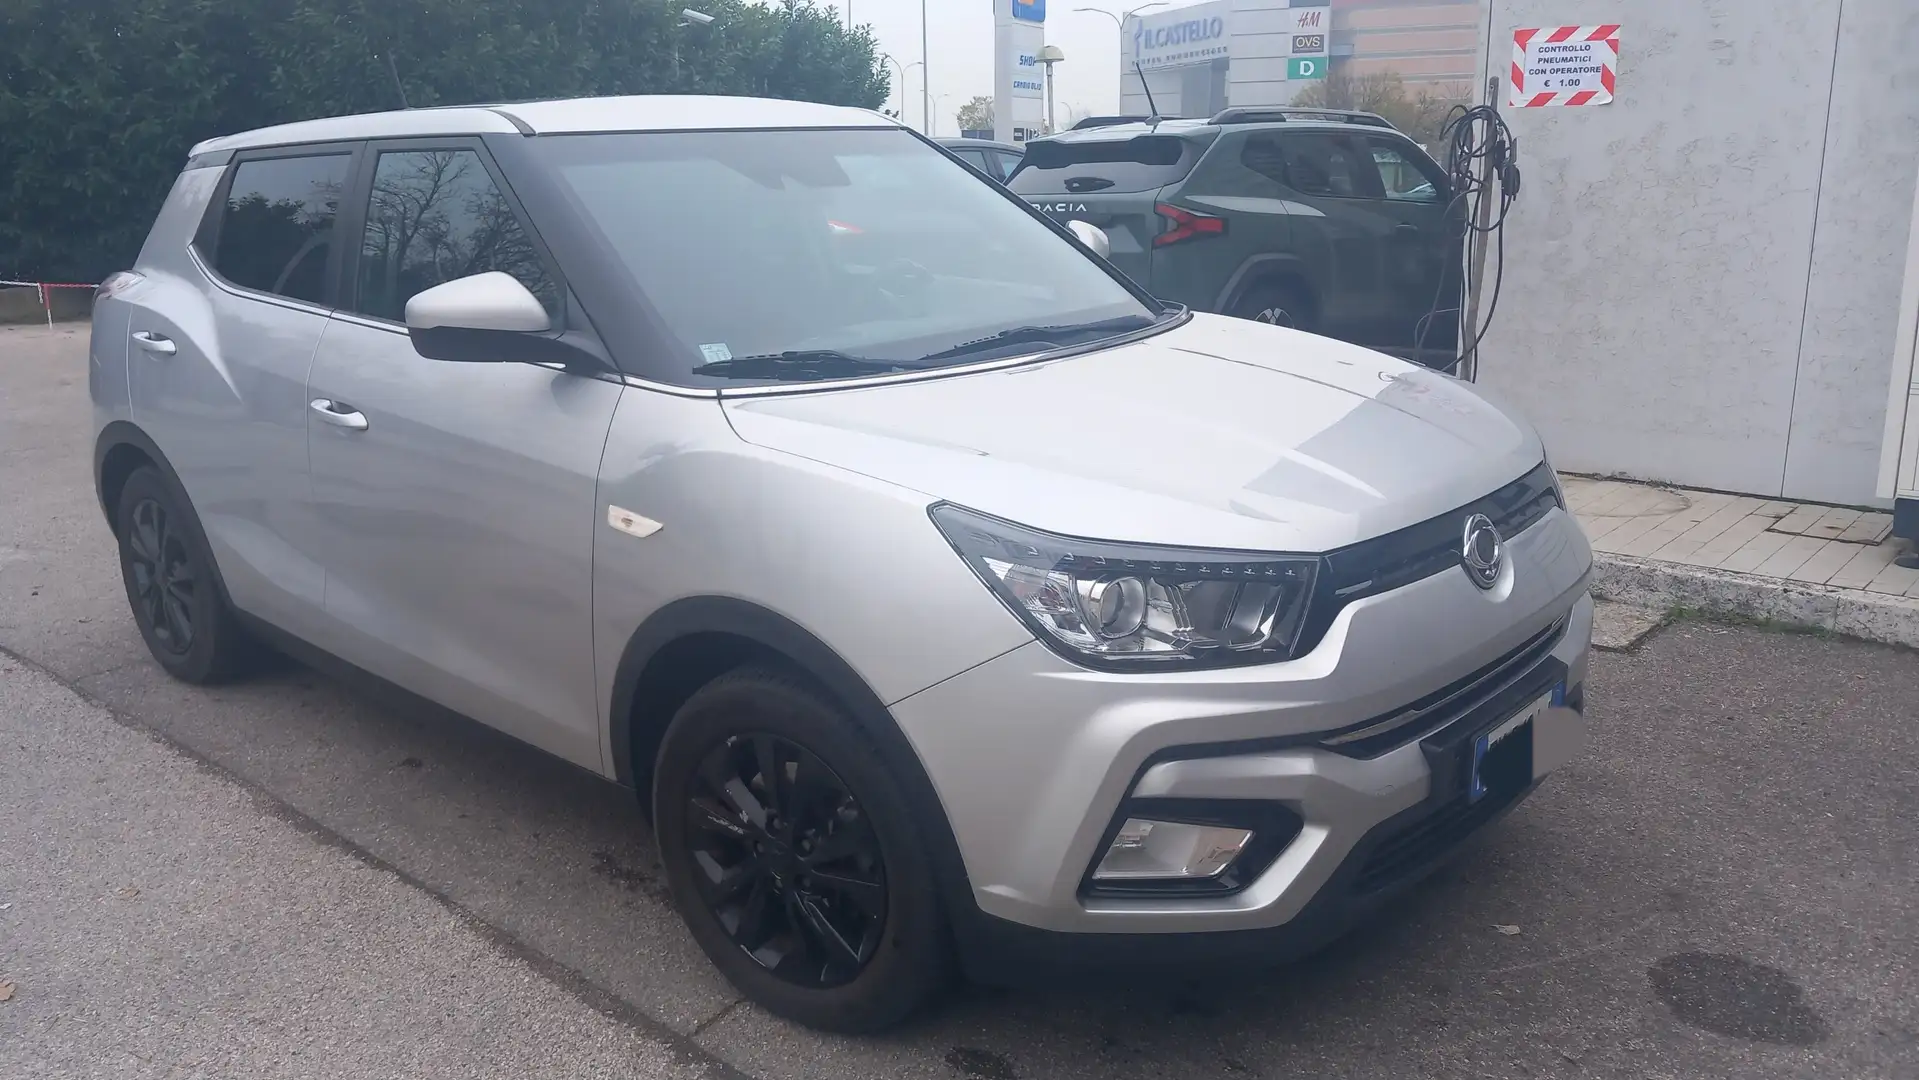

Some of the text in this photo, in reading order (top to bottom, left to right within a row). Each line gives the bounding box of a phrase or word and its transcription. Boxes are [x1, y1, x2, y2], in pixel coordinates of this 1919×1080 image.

[1144, 16, 1223, 50] IL CASTELLO
[1296, 36, 1320, 48] OVS
[1538, 44, 1591, 53] CONTROLLO
[1537, 55, 1592, 64] PNEUMATICI
[1299, 60, 1315, 76] D
[1549, 66, 1601, 75] OPERATORE
[1544, 78, 1580, 87] € 1.00
